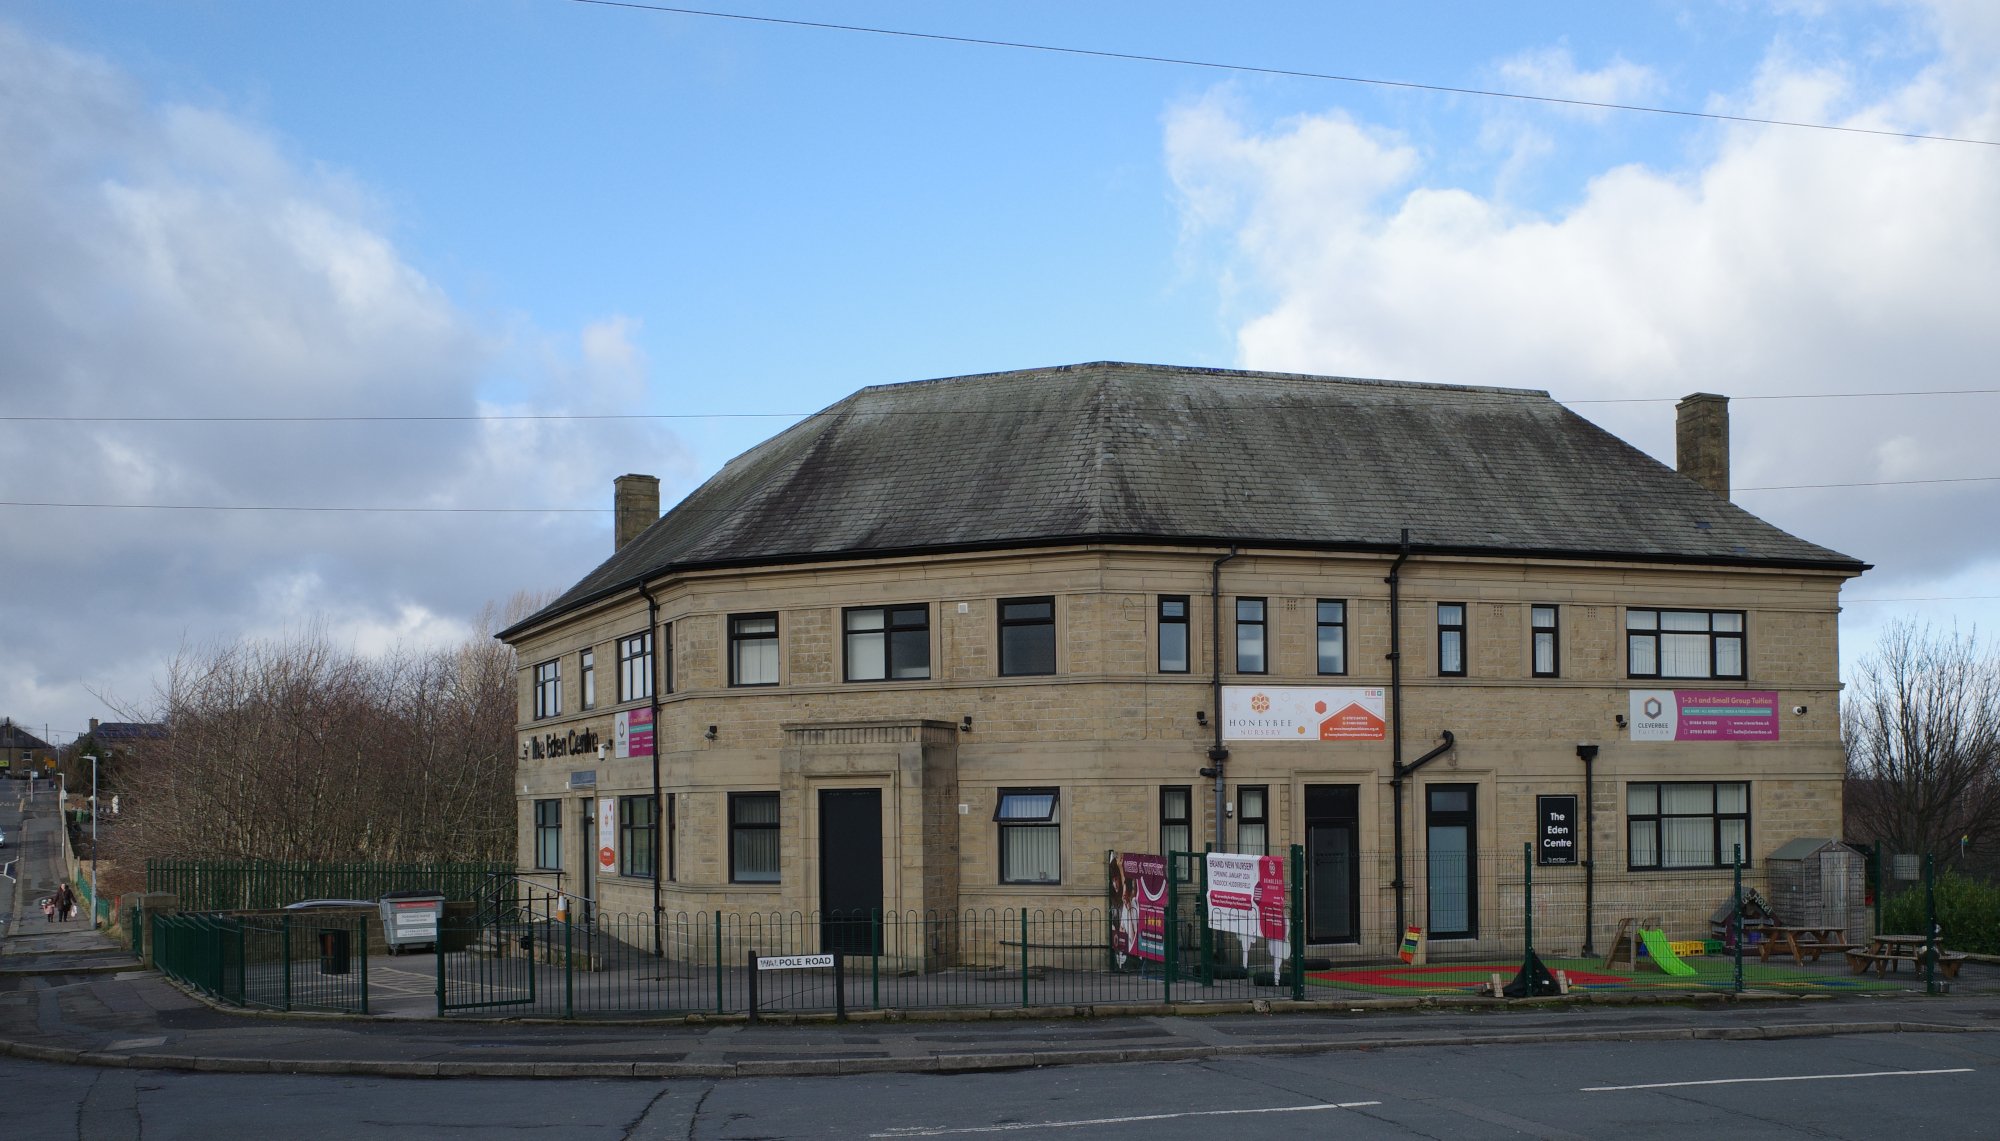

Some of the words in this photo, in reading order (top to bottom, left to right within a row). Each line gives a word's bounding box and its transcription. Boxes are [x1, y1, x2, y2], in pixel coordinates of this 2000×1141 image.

[1730, 697, 1751, 706] Group
[1229, 719, 1293, 727] HONEYBEE
[531, 736, 545, 760] The
[546, 732, 567, 758] Eden
[568, 727, 598, 756] Centre
[1550, 813, 1565, 821] The
[1548, 826, 1568, 834] Eden
[1544, 839, 1572, 848] Centre
[1209, 859, 1225, 869] BRAND
[1224, 860, 1235, 869] NEW
[1235, 861, 1254, 870] NURSERY
[760, 958, 802, 967] WALPOLE
[805, 957, 831, 965] ROAD
